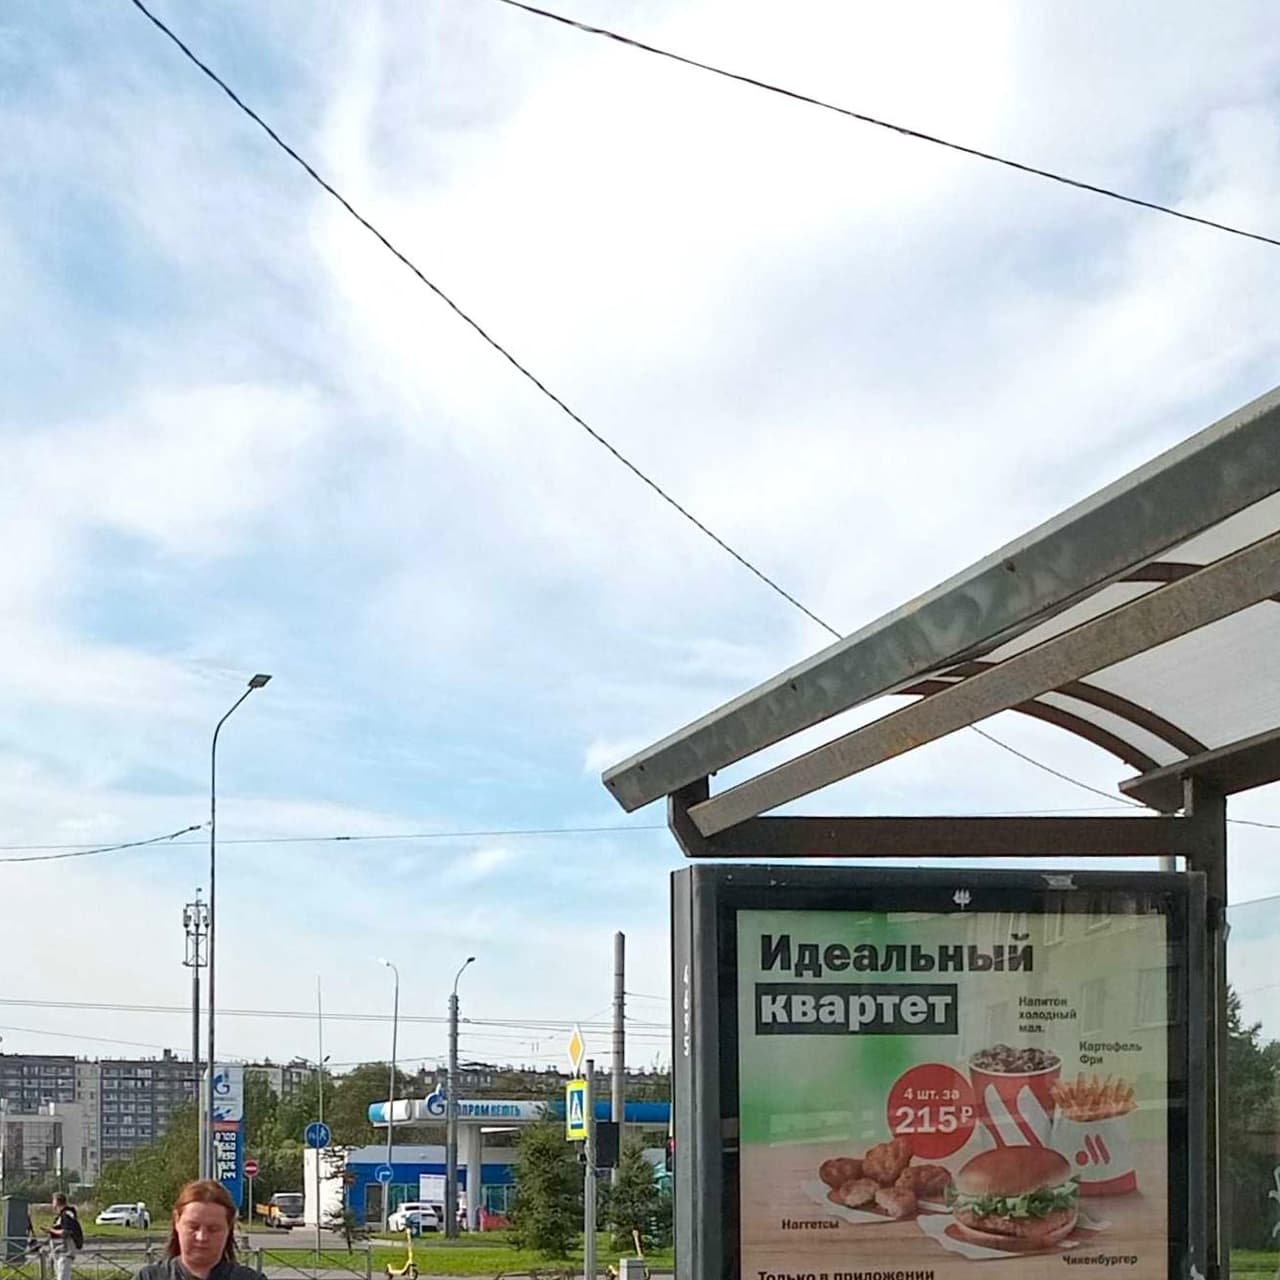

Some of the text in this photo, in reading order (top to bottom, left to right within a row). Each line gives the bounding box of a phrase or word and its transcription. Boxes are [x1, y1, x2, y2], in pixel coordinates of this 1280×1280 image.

[761, 934, 1034, 977] Идеальный
[761, 994, 952, 1031] квартет
[1019, 1009, 1077, 1020] холодный
[1080, 1041, 1143, 1052] Картофель
[1080, 1054, 1103, 1066] Фри
[904, 1088, 960, 1100] 4 шт. за
[782, 1219, 839, 1230] Наггетсы
[1062, 1254, 1138, 1266] Чикенбургер
